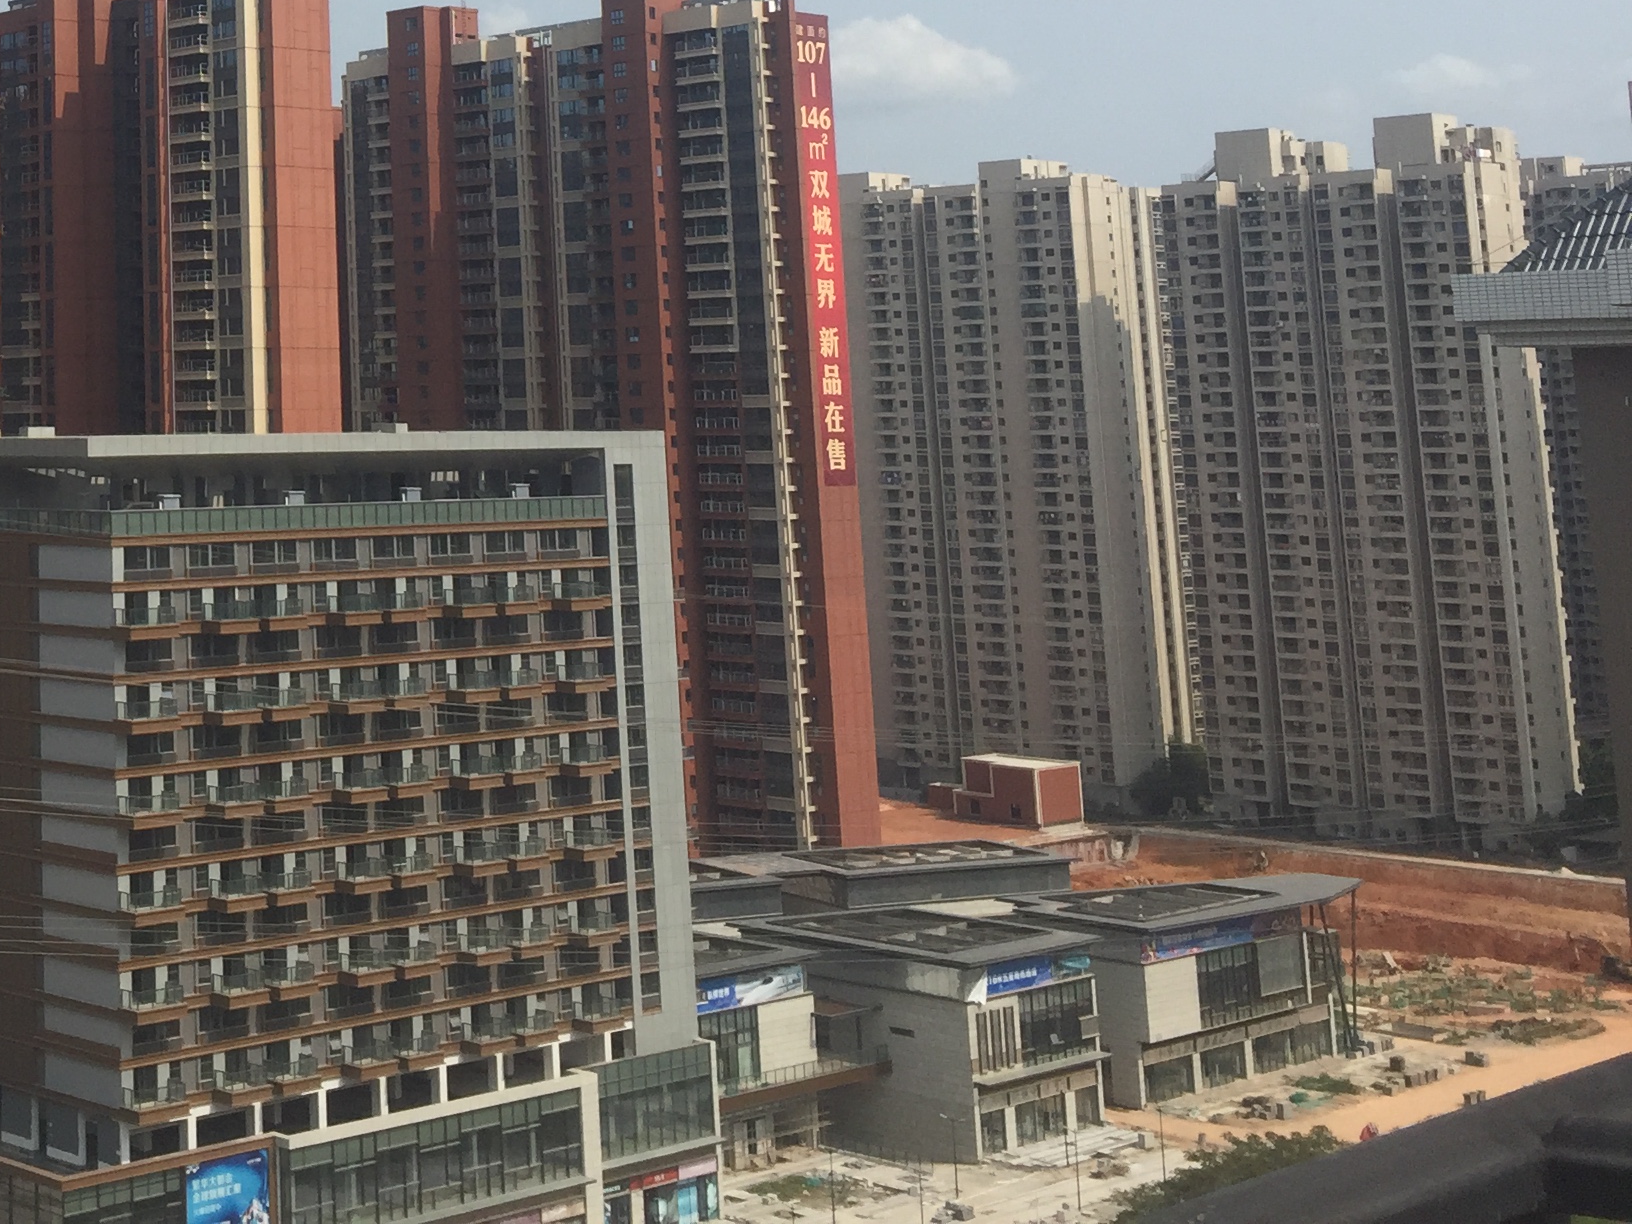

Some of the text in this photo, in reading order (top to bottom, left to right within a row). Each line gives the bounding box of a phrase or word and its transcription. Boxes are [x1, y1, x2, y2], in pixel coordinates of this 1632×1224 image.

[796, 40, 826, 65] 107
[800, 105, 832, 130] 146
[818, 326, 847, 471] 新品在售
